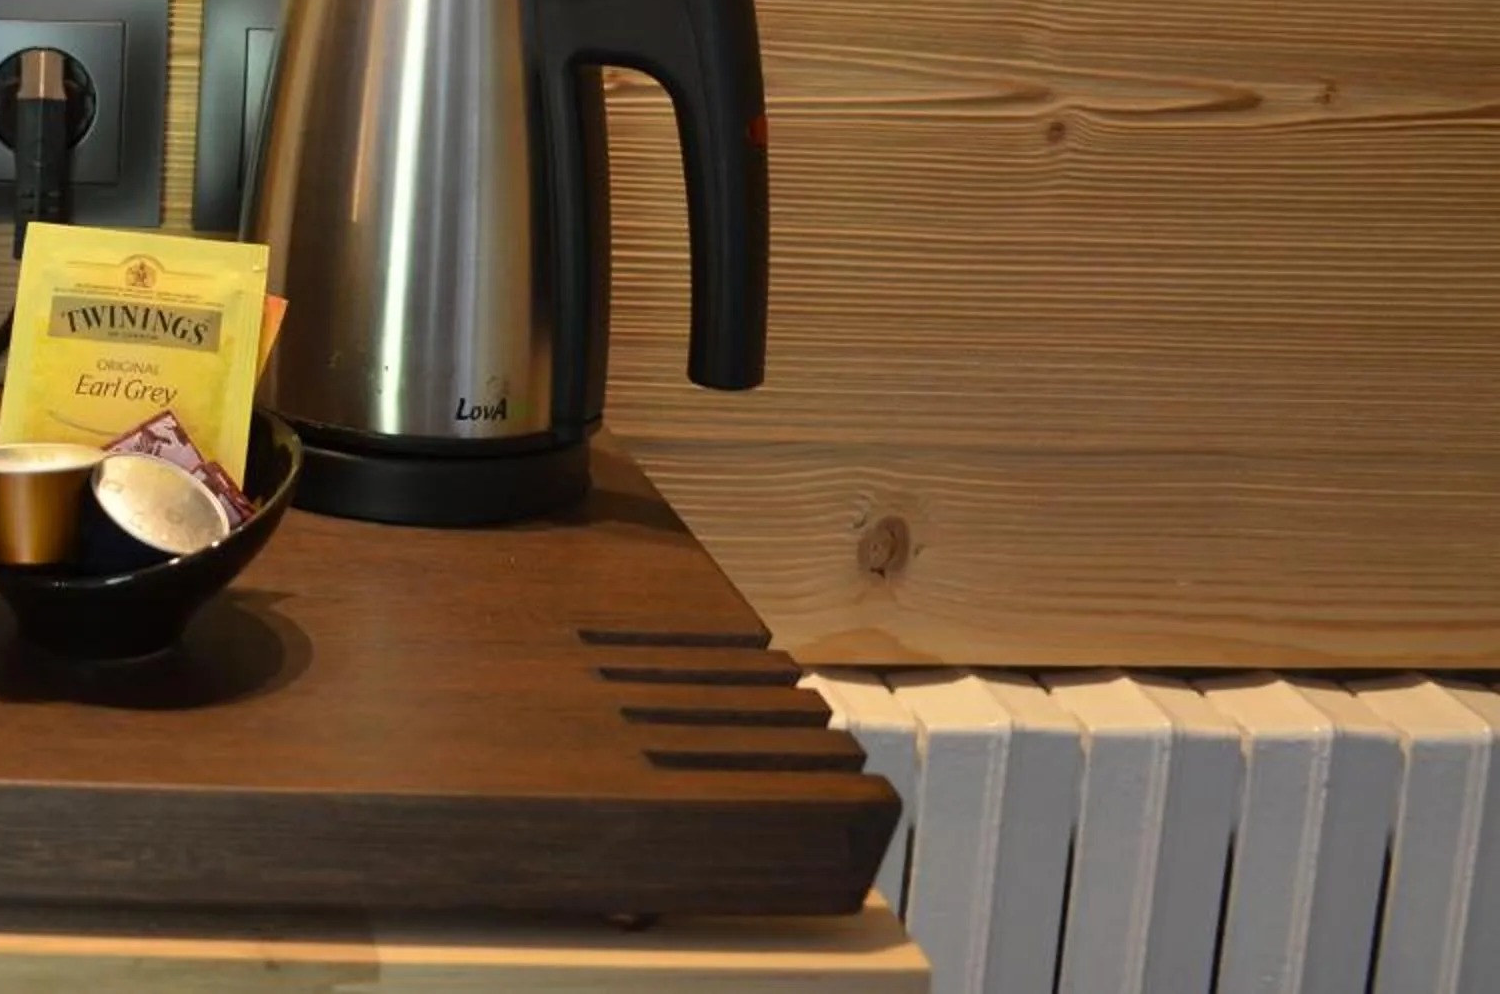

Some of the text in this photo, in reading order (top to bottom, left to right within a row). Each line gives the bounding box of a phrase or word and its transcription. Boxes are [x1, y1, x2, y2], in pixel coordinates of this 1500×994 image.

[60, 304, 210, 346] TWININGS
[96, 358, 160, 376] ORIGINAL
[75, 373, 179, 407] Earl Grey
